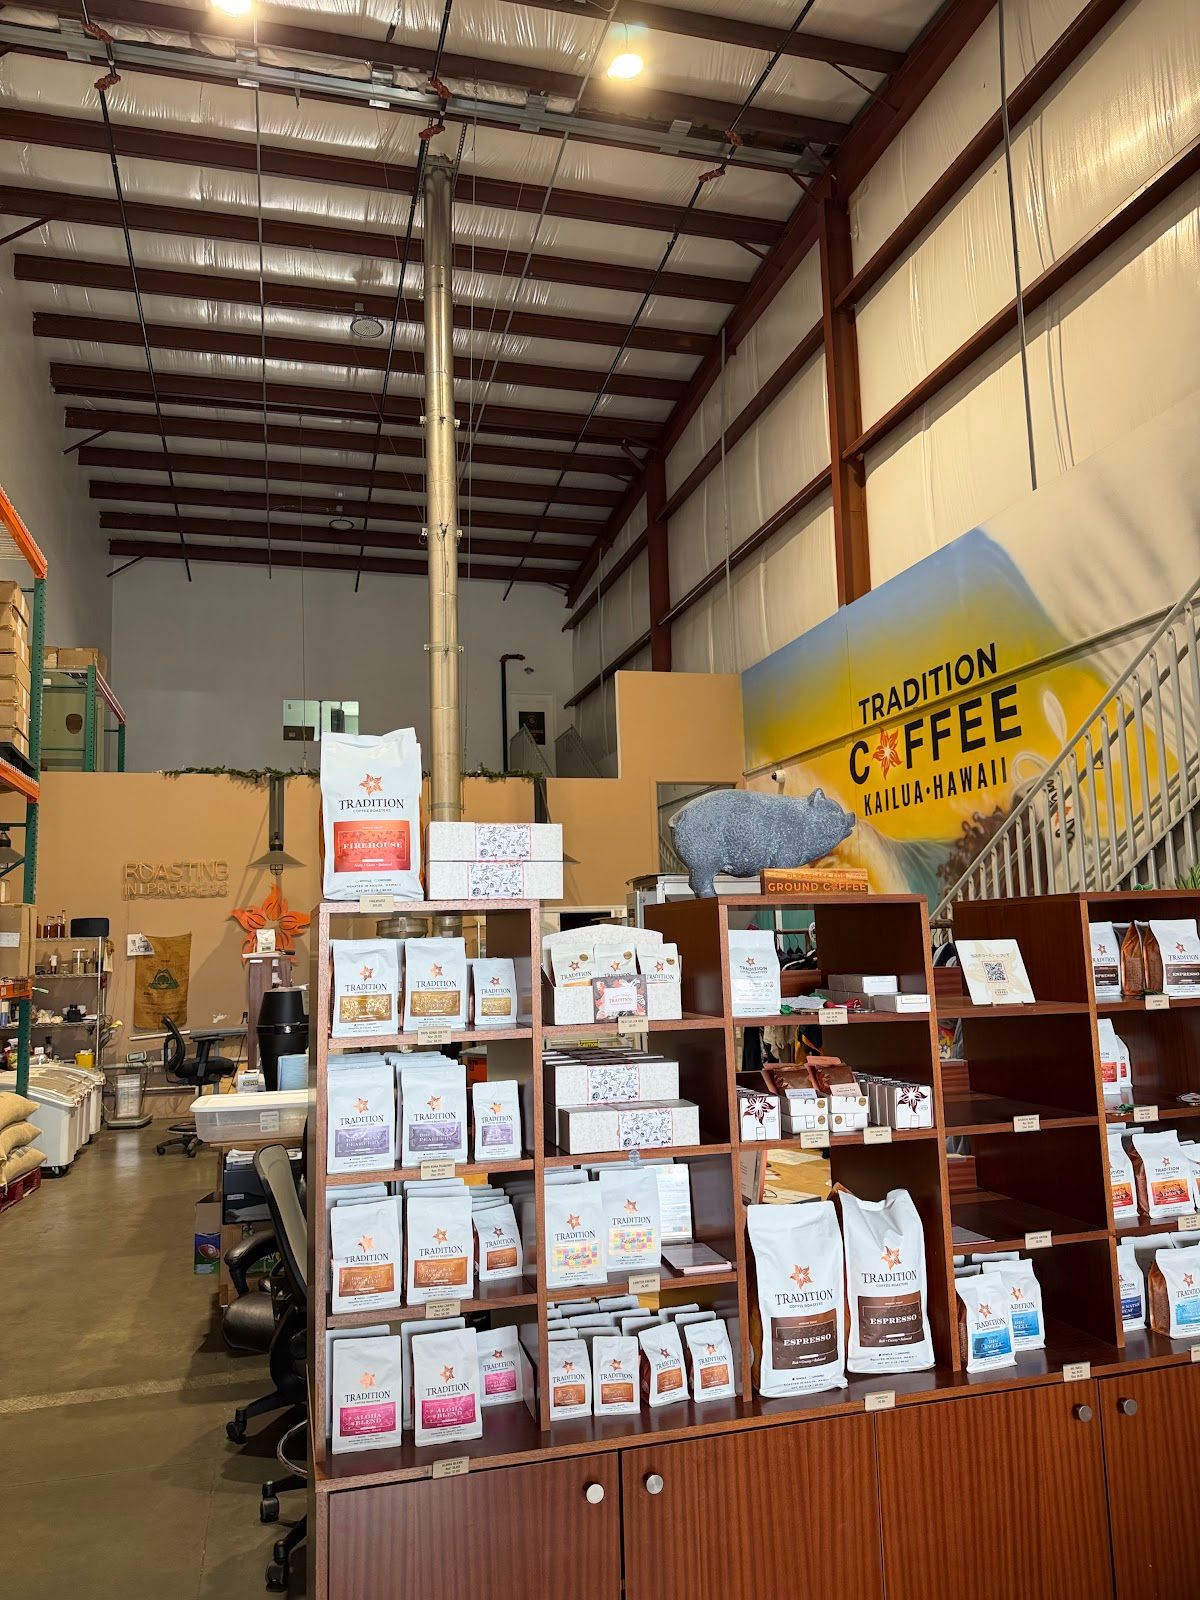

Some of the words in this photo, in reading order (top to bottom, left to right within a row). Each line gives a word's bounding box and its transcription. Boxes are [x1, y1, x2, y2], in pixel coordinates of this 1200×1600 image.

[858, 642, 997, 725] TRADITION
[339, 798, 404, 810] TRADITION
[343, 841, 403, 850] FIREHOUSE
[124, 861, 229, 882] ROASTING
[767, 882, 819, 892] GROUND
[560, 970, 592, 980] TRADITION
[345, 982, 388, 993] TRADITION
[416, 980, 457, 988] TRADITION
[609, 996, 634, 1004] TRADITION
[340, 1114, 384, 1126] TRADITION
[413, 1111, 457, 1122] TRADITION
[481, 1115, 513, 1123] TRADITION
[612, 1215, 651, 1226] TRADITION
[555, 1230, 596, 1242] TRADITION
[485, 1237, 516, 1248] TRADITION
[419, 1245, 464, 1257] TRADITION
[345, 1252, 389, 1264] TRADITION
[861, 1269, 918, 1284] TRADITION
[774, 1288, 834, 1306] TRADITION
[1176, 1288, 1200, 1298] TRADITIO
[1010, 1302, 1035, 1310] ADITION
[869, 1314, 918, 1325] ESPRESSO
[974, 1317, 1006, 1330] TRADITION
[783, 1333, 832, 1347] ESPRESSO
[655, 1358, 681, 1371] TRADITION
[698, 1354, 728, 1367] TRADITION
[483, 1360, 516, 1373] TRADITION
[552, 1372, 586, 1384] TRADITION
[600, 1372, 633, 1381] TRADITION
[426, 1382, 470, 1397] TRADITION
[345, 1390, 391, 1403] TRADITION
[436, 1405, 463, 1415] ALOHA
[436, 1411, 463, 1420] BLEND
[354, 1412, 382, 1421] ALOHA
[356, 1418, 382, 1426] BLEND
